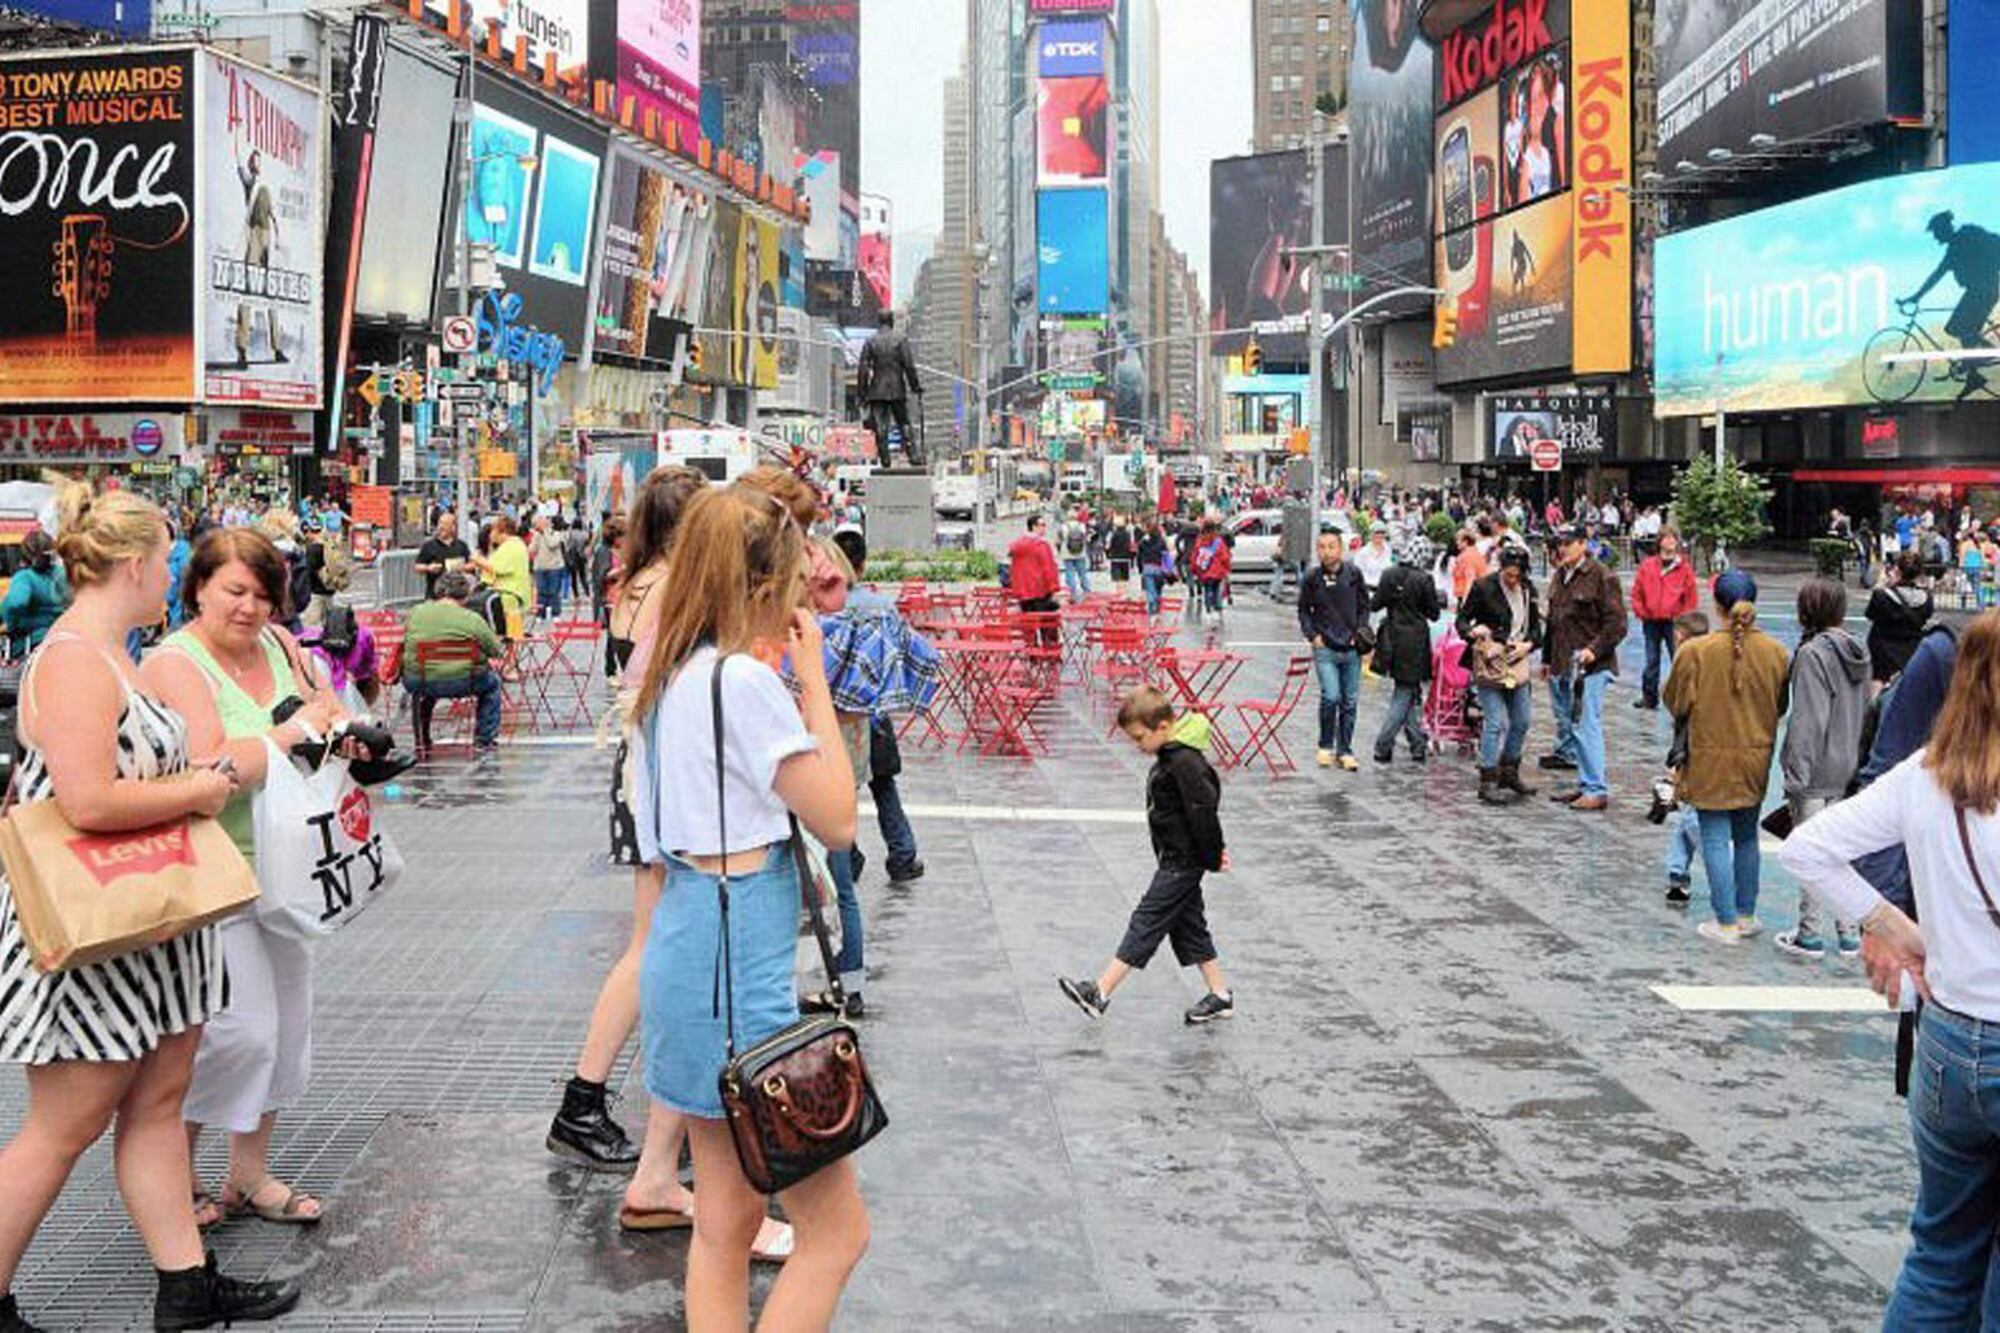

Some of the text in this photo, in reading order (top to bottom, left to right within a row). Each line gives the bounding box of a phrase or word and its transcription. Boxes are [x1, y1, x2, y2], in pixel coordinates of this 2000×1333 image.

[1056, 42, 1097, 56] TDK
[1442, 0, 1550, 103] Kodak
[9, 71, 74, 98] TONY
[77, 65, 183, 94] AWARDS
[0, 95, 183, 128] BEST MUSICAL
[1578, 56, 1623, 264] Kodak
[213, 255, 311, 304] NEWSIES
[1702, 263, 1888, 353] human
[1495, 398, 1611, 410] MARQUIS
[307, 812, 342, 868] I
[311, 833, 386, 922] NY
